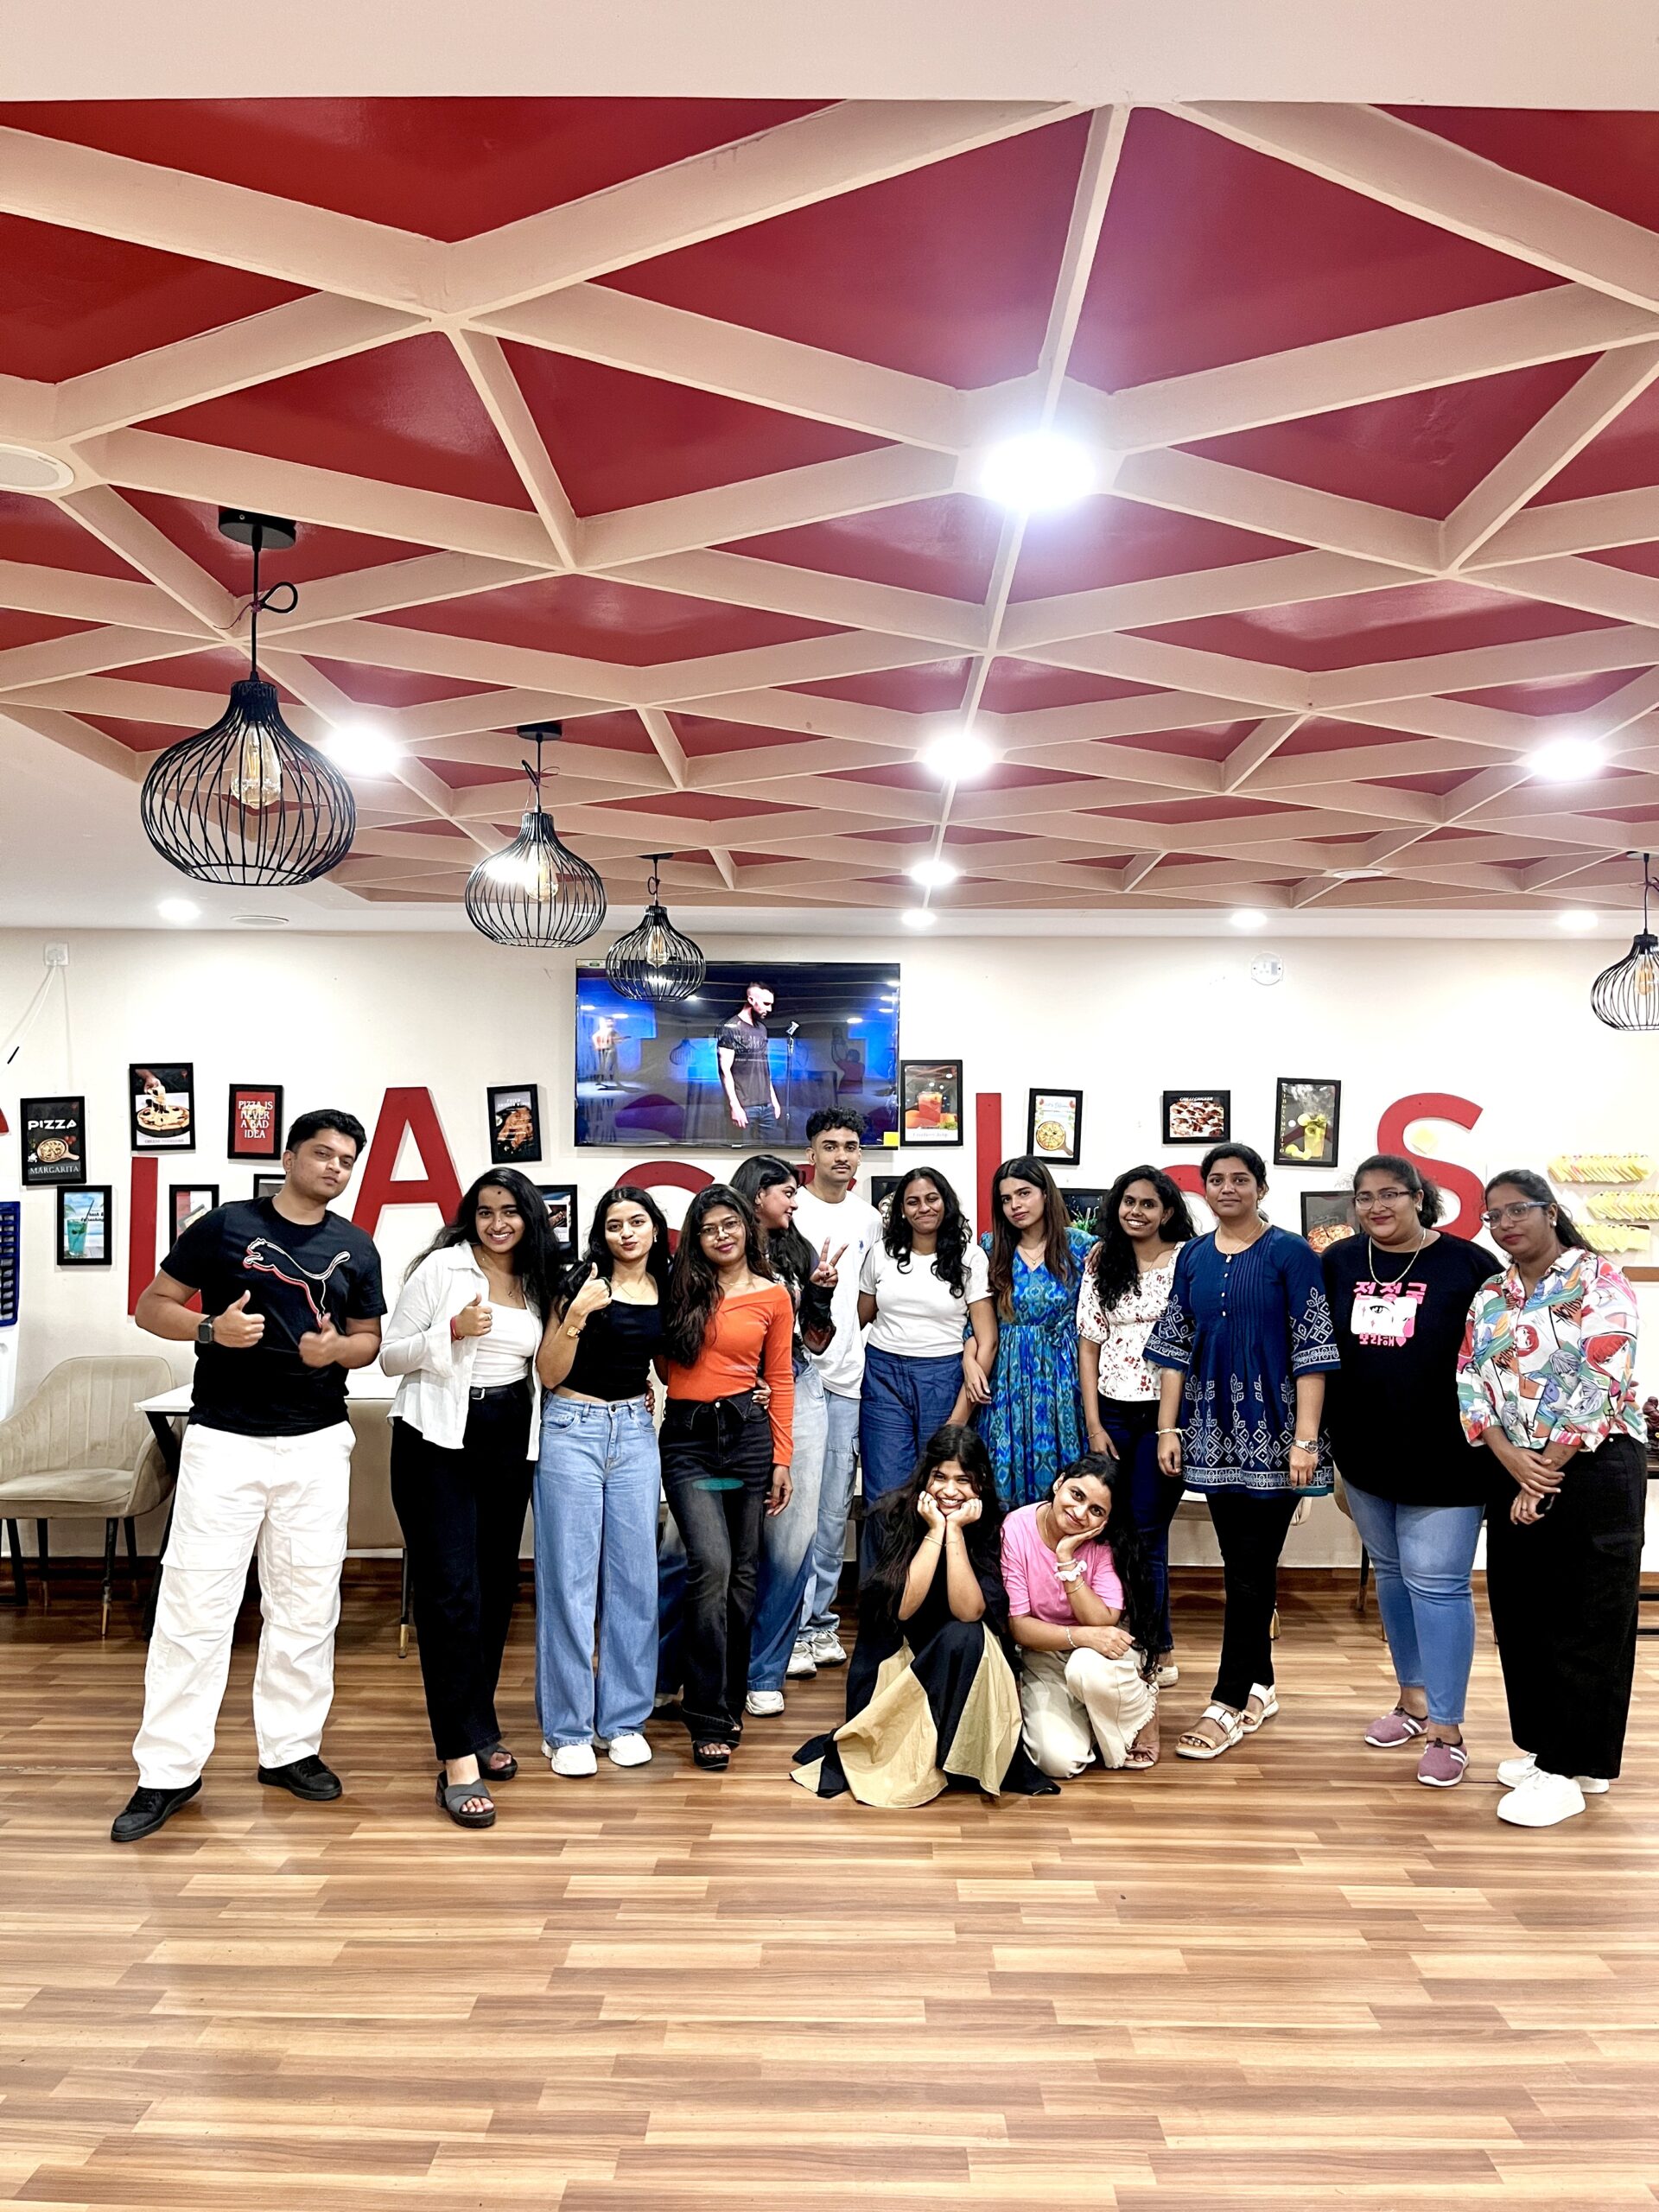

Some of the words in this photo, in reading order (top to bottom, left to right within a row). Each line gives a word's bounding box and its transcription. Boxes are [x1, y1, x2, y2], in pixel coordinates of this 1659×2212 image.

[238, 1101, 261, 1109] PIZZA
[265, 1101, 273, 1109] IS
[240, 1110, 270, 1119] NEVER
[28, 1119, 77, 1131] PIZZA
[241, 1120, 247, 1128] A
[250, 1119, 270, 1128] BAD
[245, 1129, 266, 1138] IDEA
[29, 1166, 79, 1175] MARGARITA
[1353, 1281, 1427, 1305] 전정국
